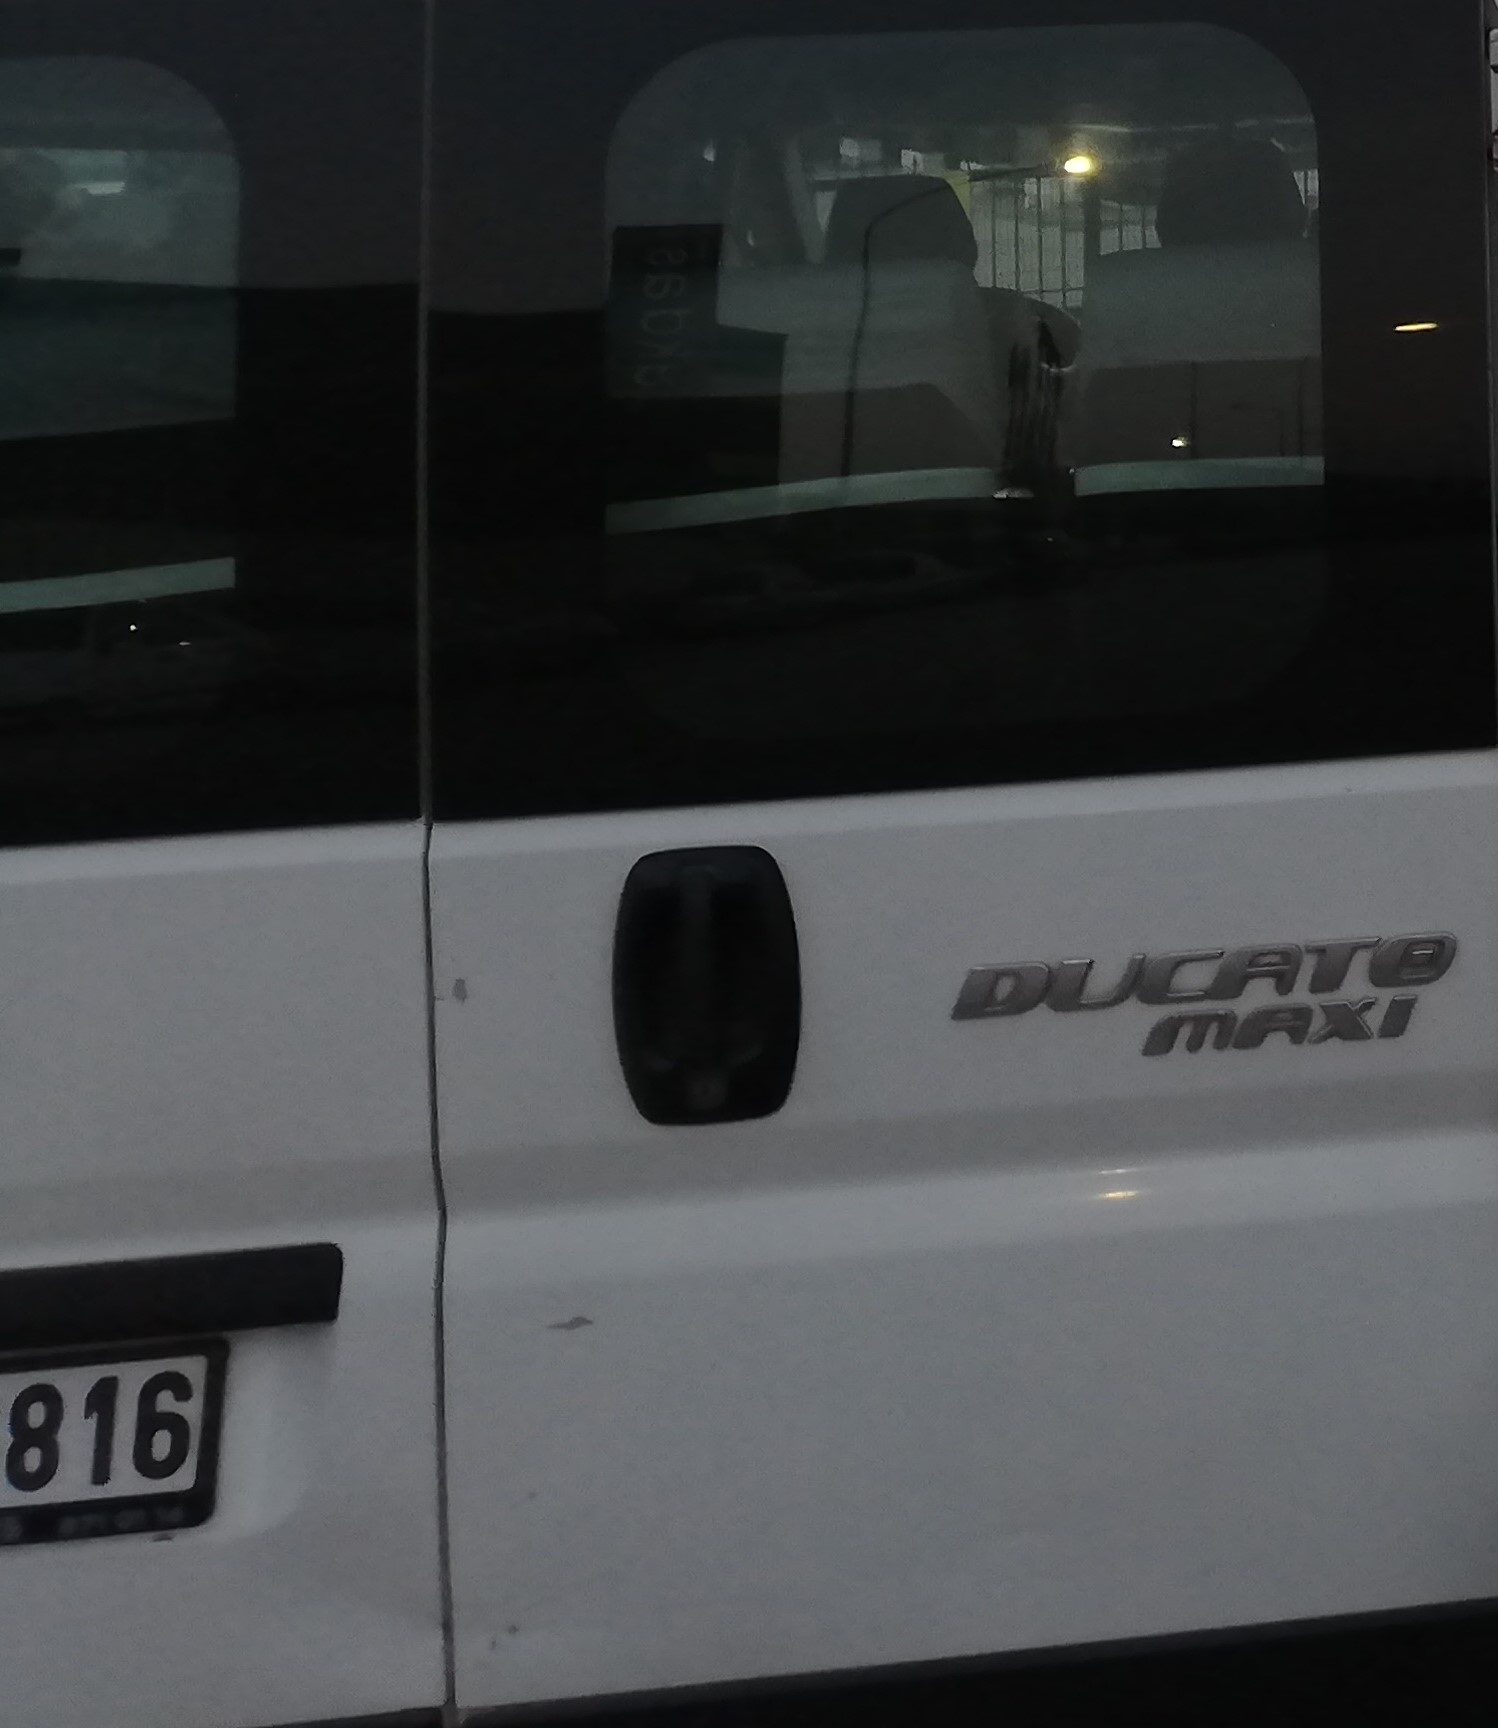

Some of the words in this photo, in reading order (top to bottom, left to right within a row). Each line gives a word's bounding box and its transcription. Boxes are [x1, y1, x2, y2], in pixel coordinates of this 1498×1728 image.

[951, 931, 1459, 1021] DUCATO
[1142, 994, 1418, 1057] MAXI
[6, 1370, 193, 1492] 816
